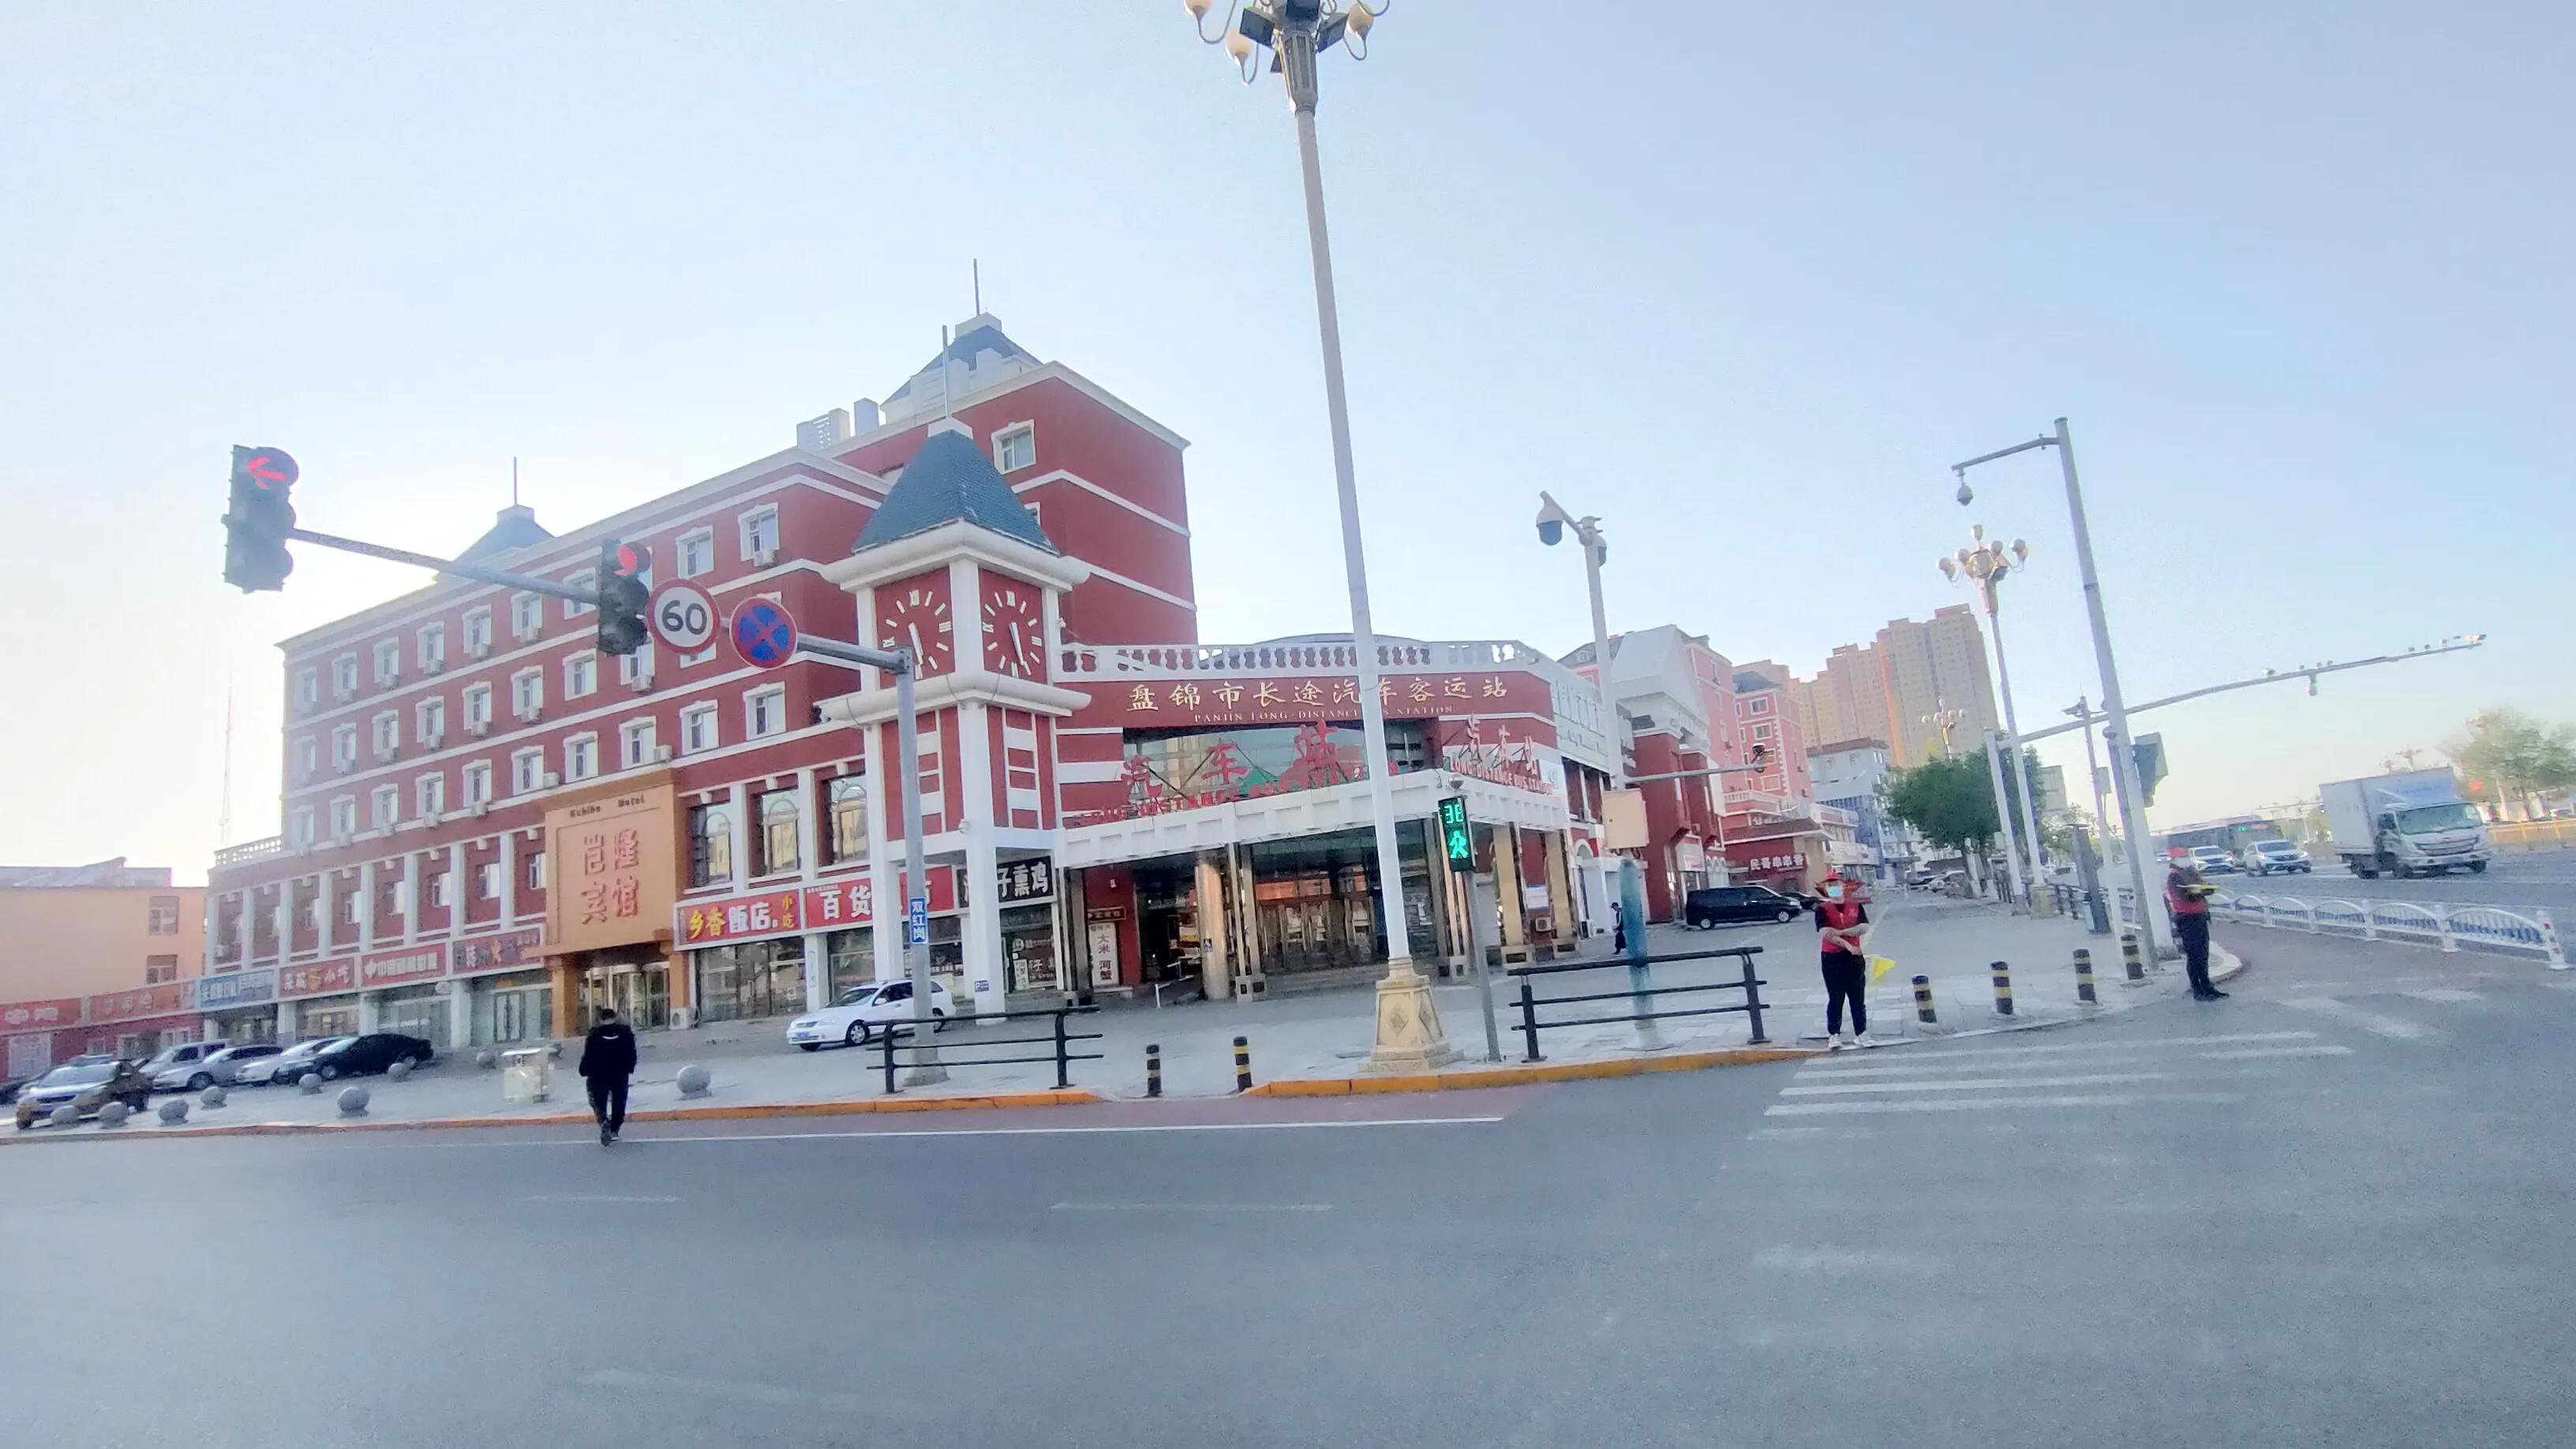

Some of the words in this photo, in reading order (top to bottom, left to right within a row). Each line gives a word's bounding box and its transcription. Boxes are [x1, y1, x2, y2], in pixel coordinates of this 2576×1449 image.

[662, 600, 707, 635] 60
[1126, 676, 1507, 711] 盘锦市长途汽车客运站
[1194, 712, 1244, 723] PANJIN
[1121, 719, 1338, 798] 汽车站
[782, 896, 795, 929] 小吃
[912, 900, 926, 942] 双红岗
[1097, 934, 1111, 954] 大米
